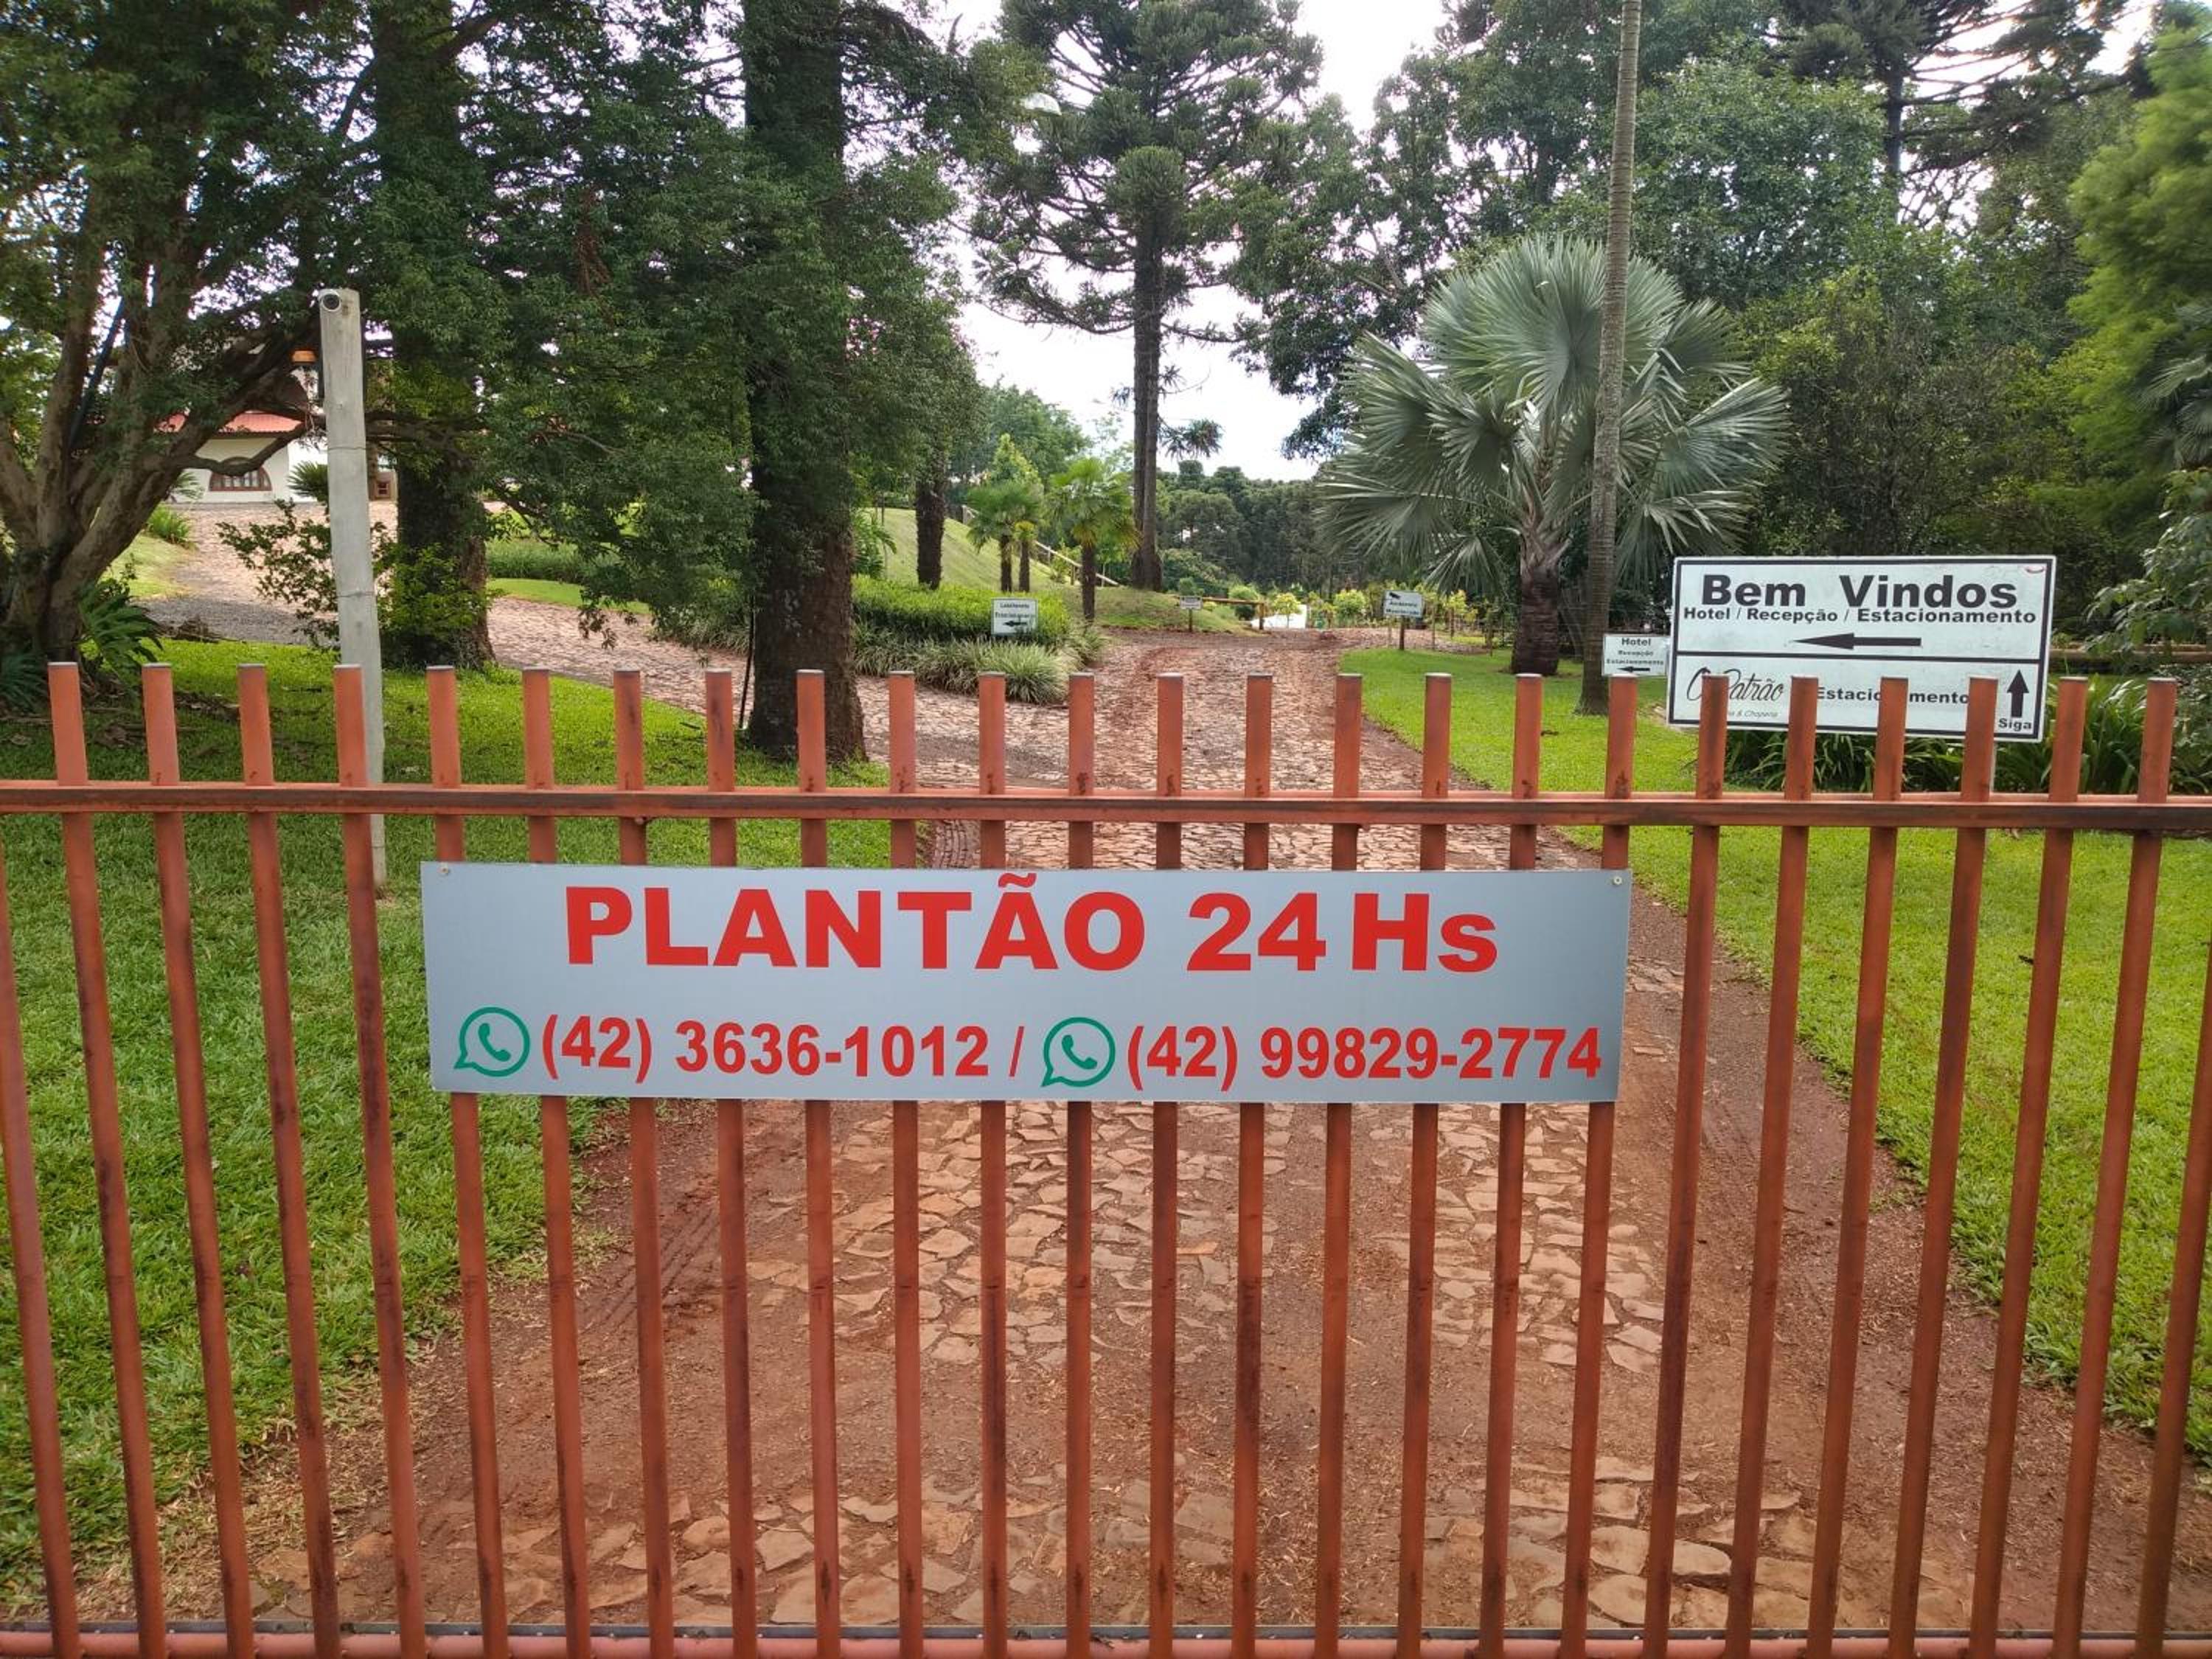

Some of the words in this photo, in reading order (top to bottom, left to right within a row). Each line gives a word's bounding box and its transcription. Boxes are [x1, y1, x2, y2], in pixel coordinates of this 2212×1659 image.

[1702, 574, 1806, 607] Bem
[1839, 574, 2017, 608] Vindos
[1684, 607, 1731, 620] Hotel
[1735, 607, 1742, 620] /
[1747, 608, 1838, 625] Recepção
[1843, 608, 1850, 622] /
[1857, 608, 2037, 624] Estacionamento
[1621, 638, 1652, 647] Hotel
[1818, 686, 1969, 705] Estaciomento
[1998, 717, 2032, 731] Siga
[566, 872, 1145, 972] PLANTÃO
[1186, 891, 1328, 973] 24
[1352, 892, 1498, 973] Hs
[542, 1014, 652, 1082] (42)
[675, 1019, 989, 1078] 3636-1012
[1009, 1026, 1025, 1079] /
[1127, 1025, 1239, 1093] (42)
[1259, 1026, 1602, 1079] 99829-2774
